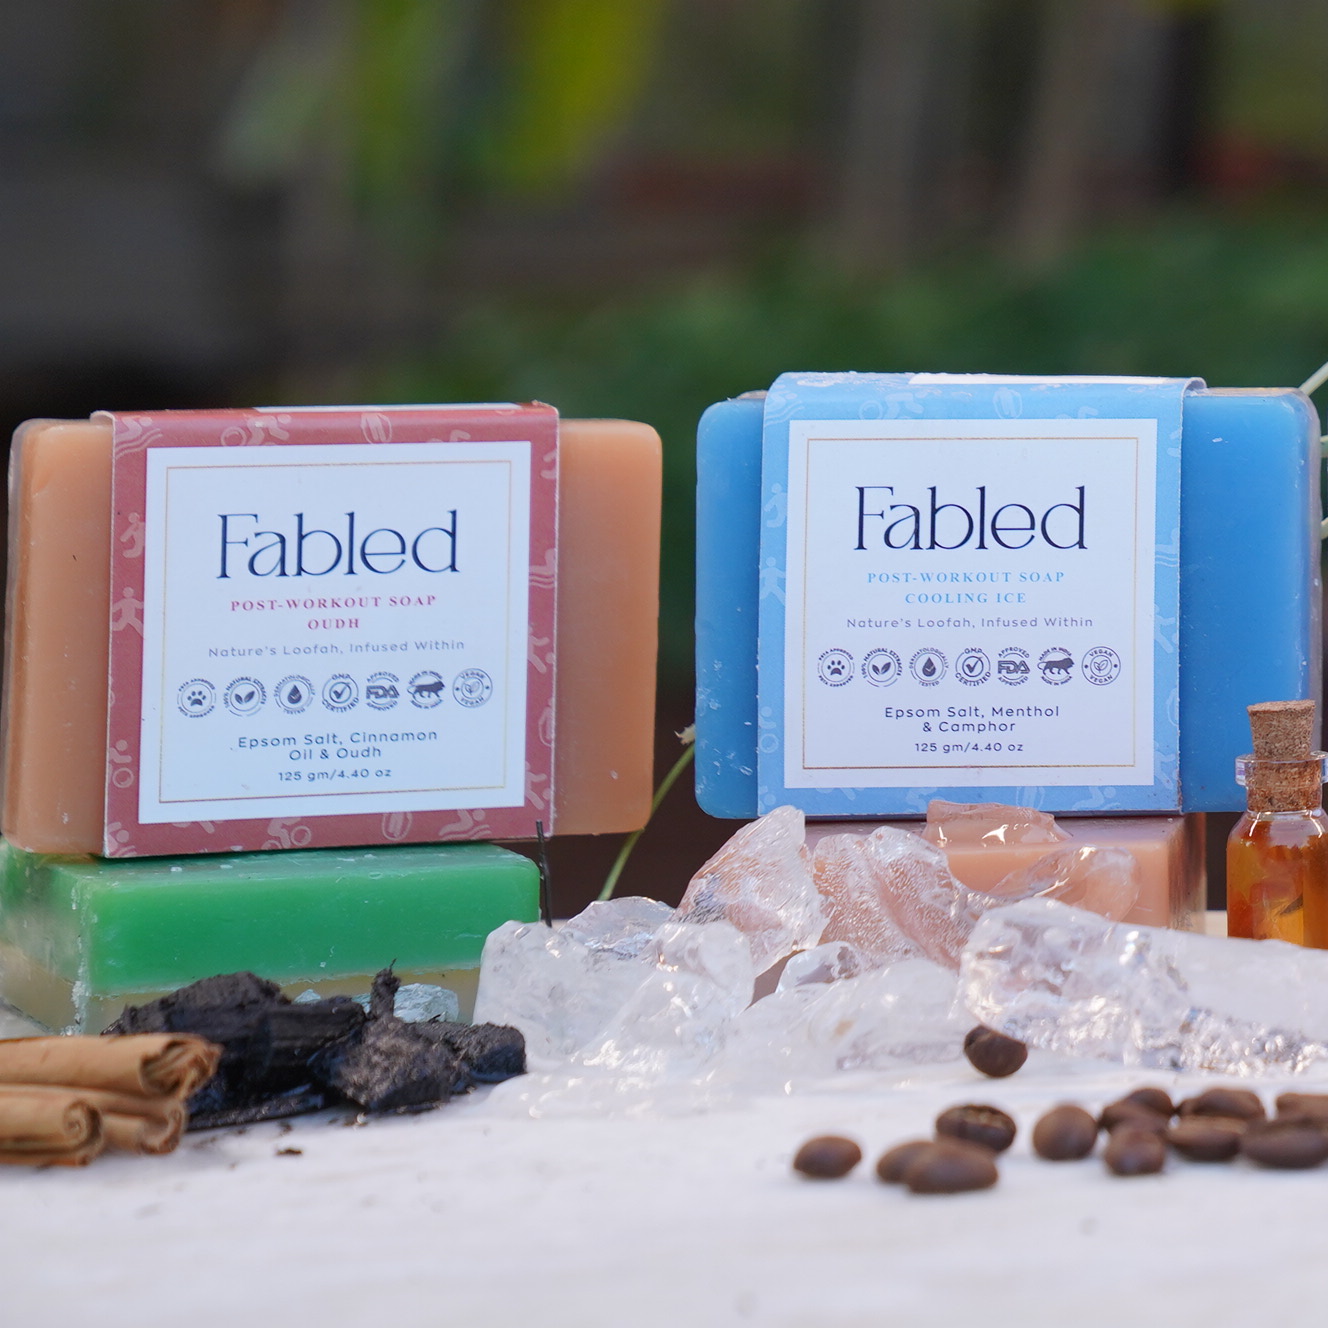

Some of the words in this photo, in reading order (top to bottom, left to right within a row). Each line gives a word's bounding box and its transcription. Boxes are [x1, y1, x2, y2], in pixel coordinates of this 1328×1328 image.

[854, 486, 1088, 550] Fabled
[217, 510, 459, 578] Fabled
[868, 572, 1011, 583] POST-WORKOUT
[1019, 572, 1064, 582] SOAP
[231, 597, 381, 611] POST-WORKOUT
[389, 596, 435, 606] SOAP
[905, 593, 987, 603] COOLING
[997, 593, 1025, 603] ICE
[308, 619, 358, 629] OUDH
[847, 618, 911, 628] Nature's
[918, 617, 975, 628] Loofah,
[982, 617, 1037, 627] Infused
[1044, 617, 1092, 627] Within
[209, 646, 276, 657] Nature's
[283, 644, 343, 655] Loofah,
[350, 641, 408, 652] Infused
[415, 640, 464, 650] Within
[864, 648, 888, 662] NATURAL
[998, 647, 1030, 659] APPROVED
[1089, 649, 1113, 658] VEGAN
[997, 660, 1031, 674] FDA
[955, 672, 991, 687] CERTIFIED
[1089, 675, 1113, 683] VEGAN
[366, 684, 400, 700] FDA
[885, 707, 940, 719] Epsom
[948, 706, 984, 718] Salt,
[992, 706, 1058, 716] Menthol
[923, 722, 931, 732] &
[939, 721, 1015, 733] Camphor
[239, 737, 296, 749] Epsom
[304, 733, 342, 745] Salt,
[350, 732, 437, 743] Cinnamon
[289, 749, 312, 760] Oil
[320, 749, 328, 759] &
[336, 744, 381, 759] Oudh
[915, 743, 937, 752] 125
[943, 742, 1002, 753] gm/4.40
[278, 771, 301, 781] 125
[307, 769, 369, 782] gm/4.40
